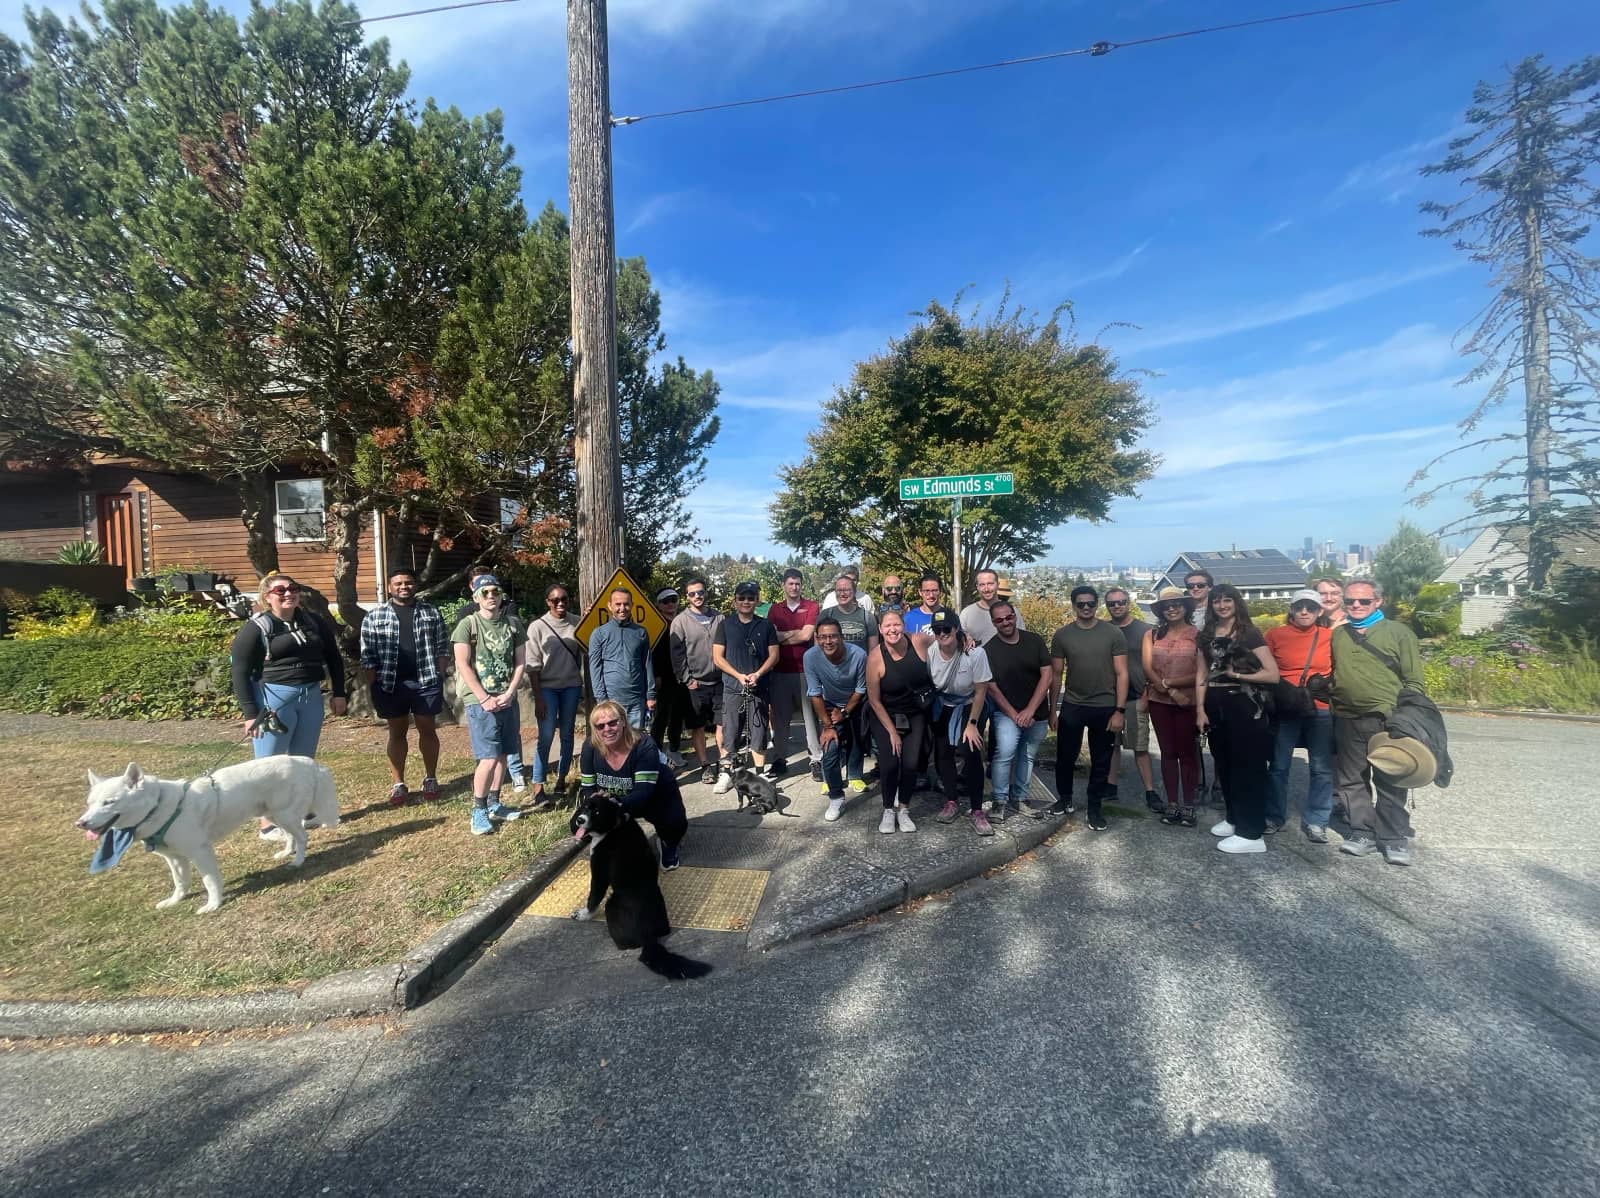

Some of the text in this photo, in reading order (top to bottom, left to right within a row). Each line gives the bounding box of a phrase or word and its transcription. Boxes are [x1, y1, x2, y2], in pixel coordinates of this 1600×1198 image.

[904, 478, 994, 495] SW Edmunds St
[994, 474, 1011, 482] 4700
[598, 605, 646, 626] DD
